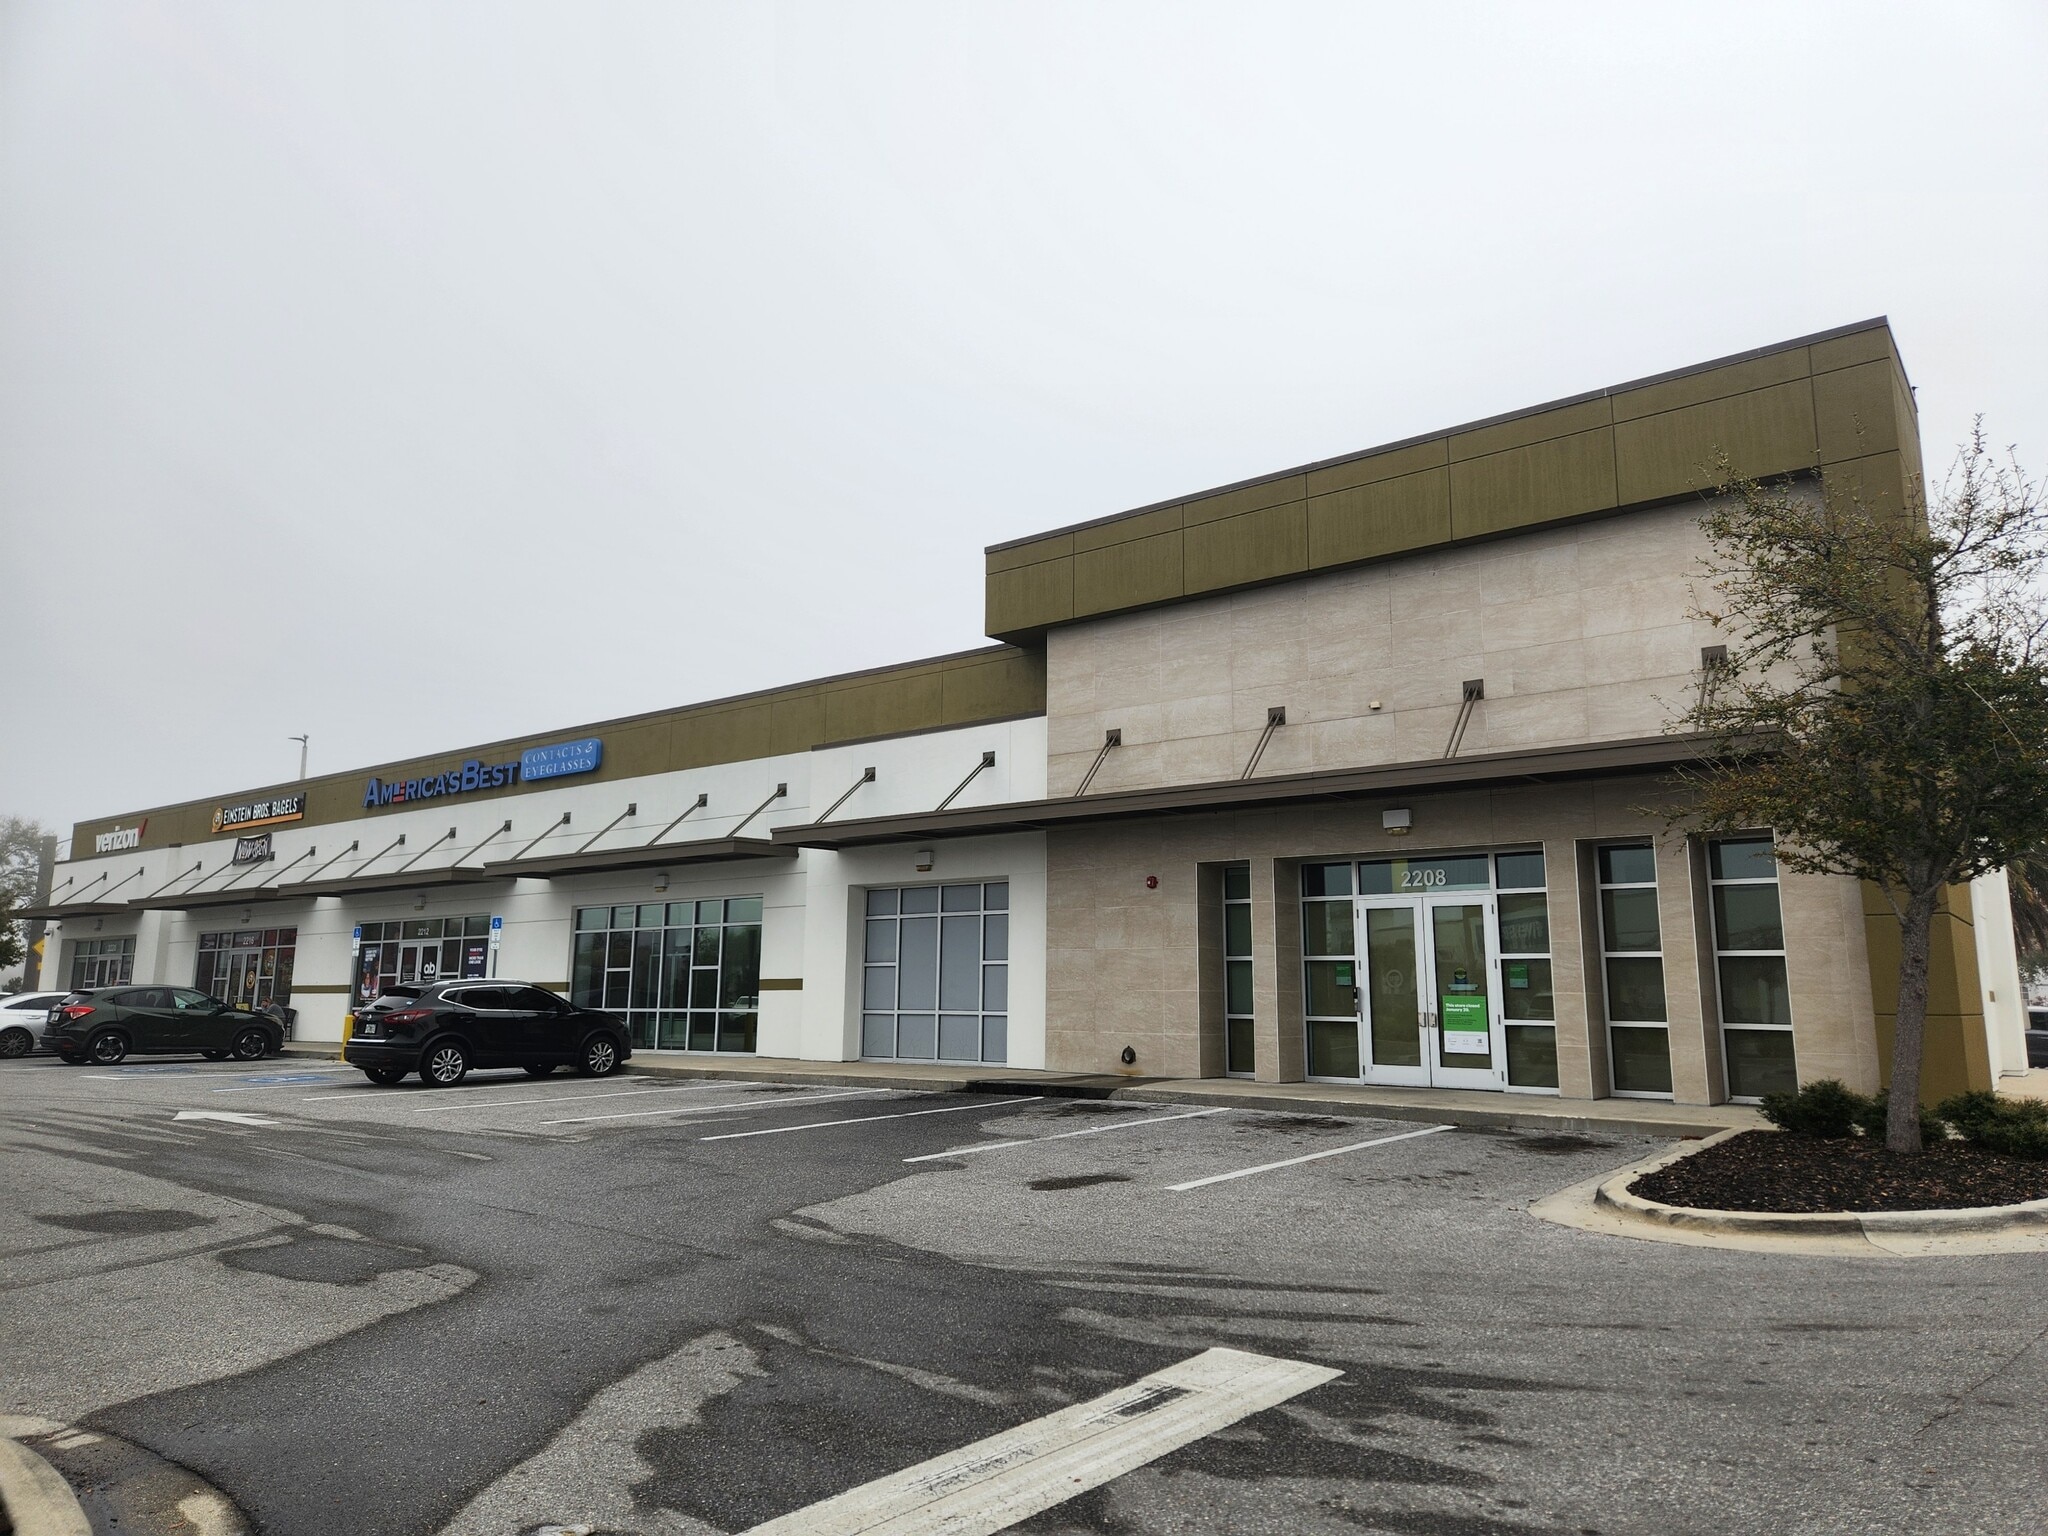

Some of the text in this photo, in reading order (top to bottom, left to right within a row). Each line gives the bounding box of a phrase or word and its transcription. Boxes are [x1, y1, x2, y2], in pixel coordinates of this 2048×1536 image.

[525, 746, 582, 764] CONTACTS
[525, 758, 592, 778] EYEGLASSES
[362, 760, 519, 807] AMERICA'S BEST
[223, 798, 298, 824] EINSTEIN BROS. BAGELS
[96, 826, 139, 853] verizon
[1401, 869, 1447, 887] 2208
[417, 928, 430, 936] 2212
